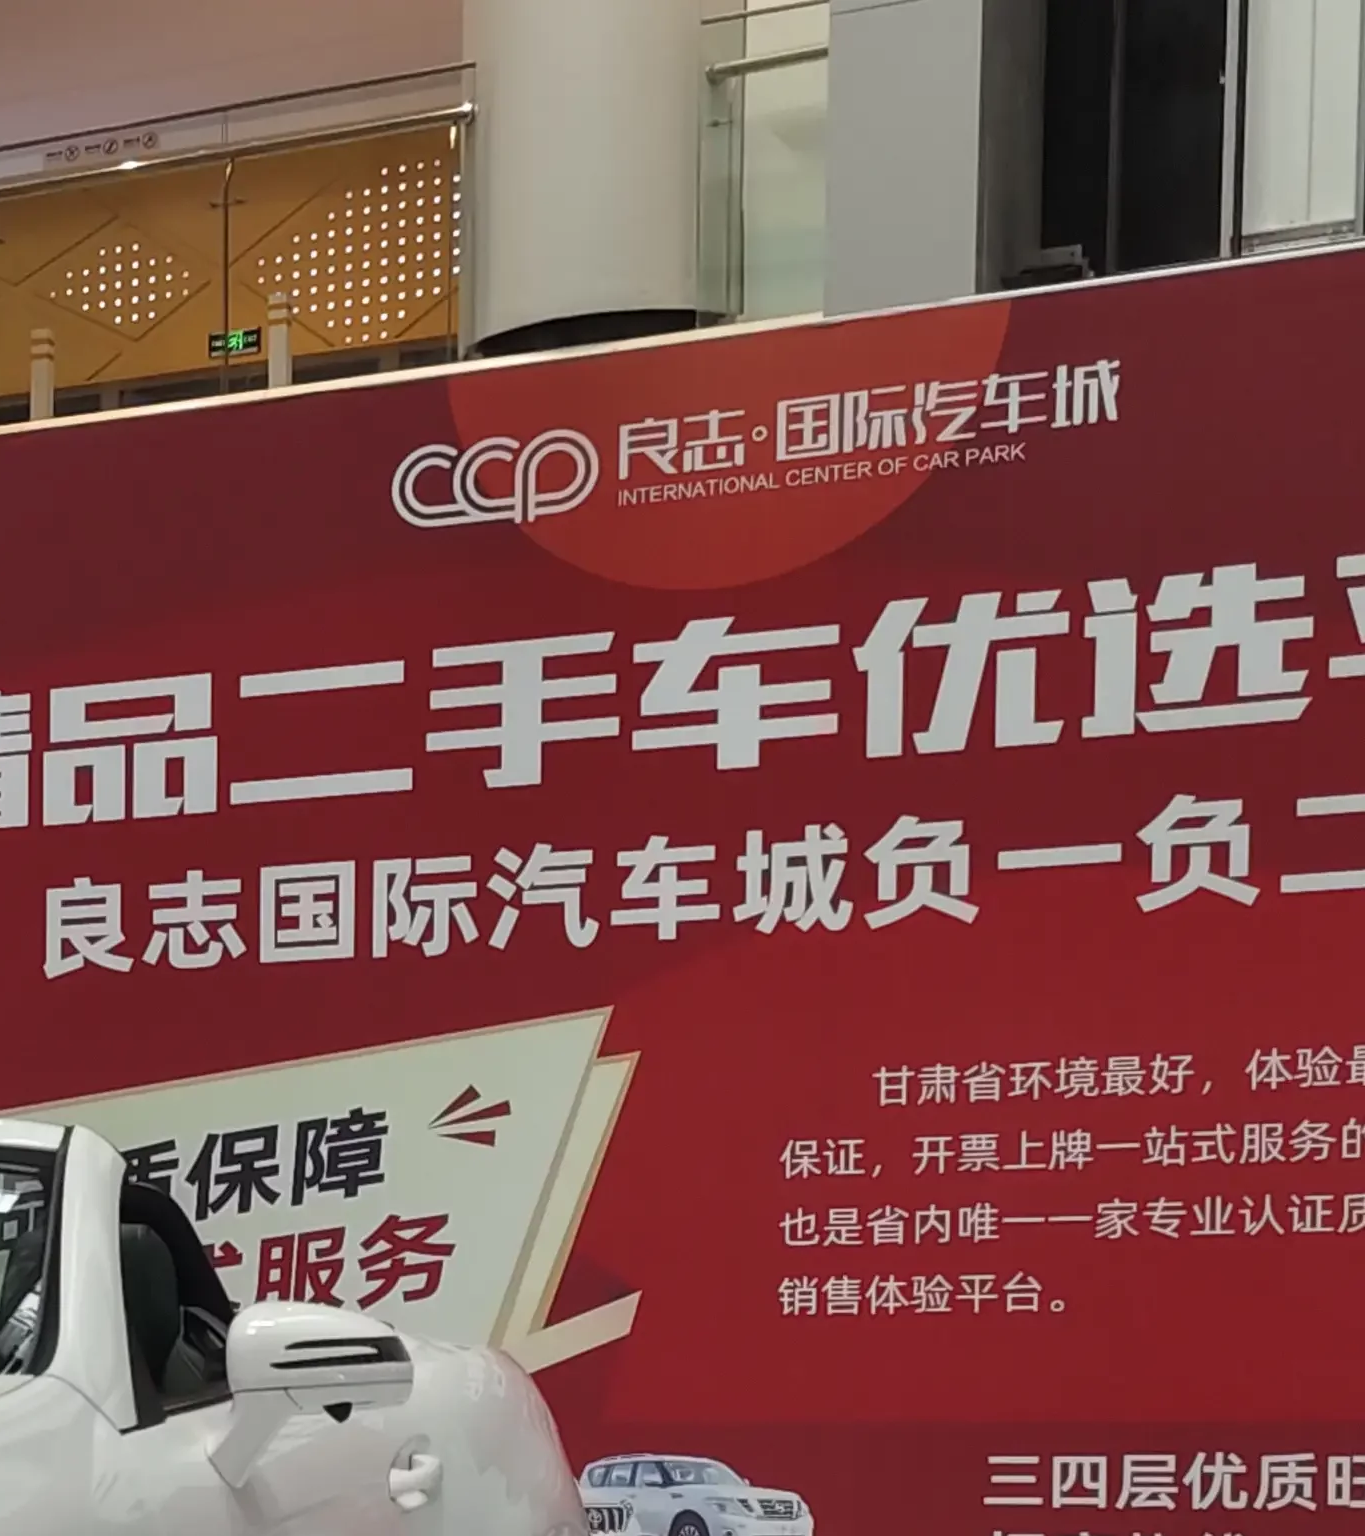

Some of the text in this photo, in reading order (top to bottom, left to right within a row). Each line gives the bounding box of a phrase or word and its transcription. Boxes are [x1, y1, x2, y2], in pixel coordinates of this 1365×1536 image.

[618, 442, 1026, 507] INTERNATIONAL CENTER OF CAR PARK
[778, 1271, 1065, 1315] 销售体验平台。
[983, 1451, 1365, 1511] 三四层优质旺
